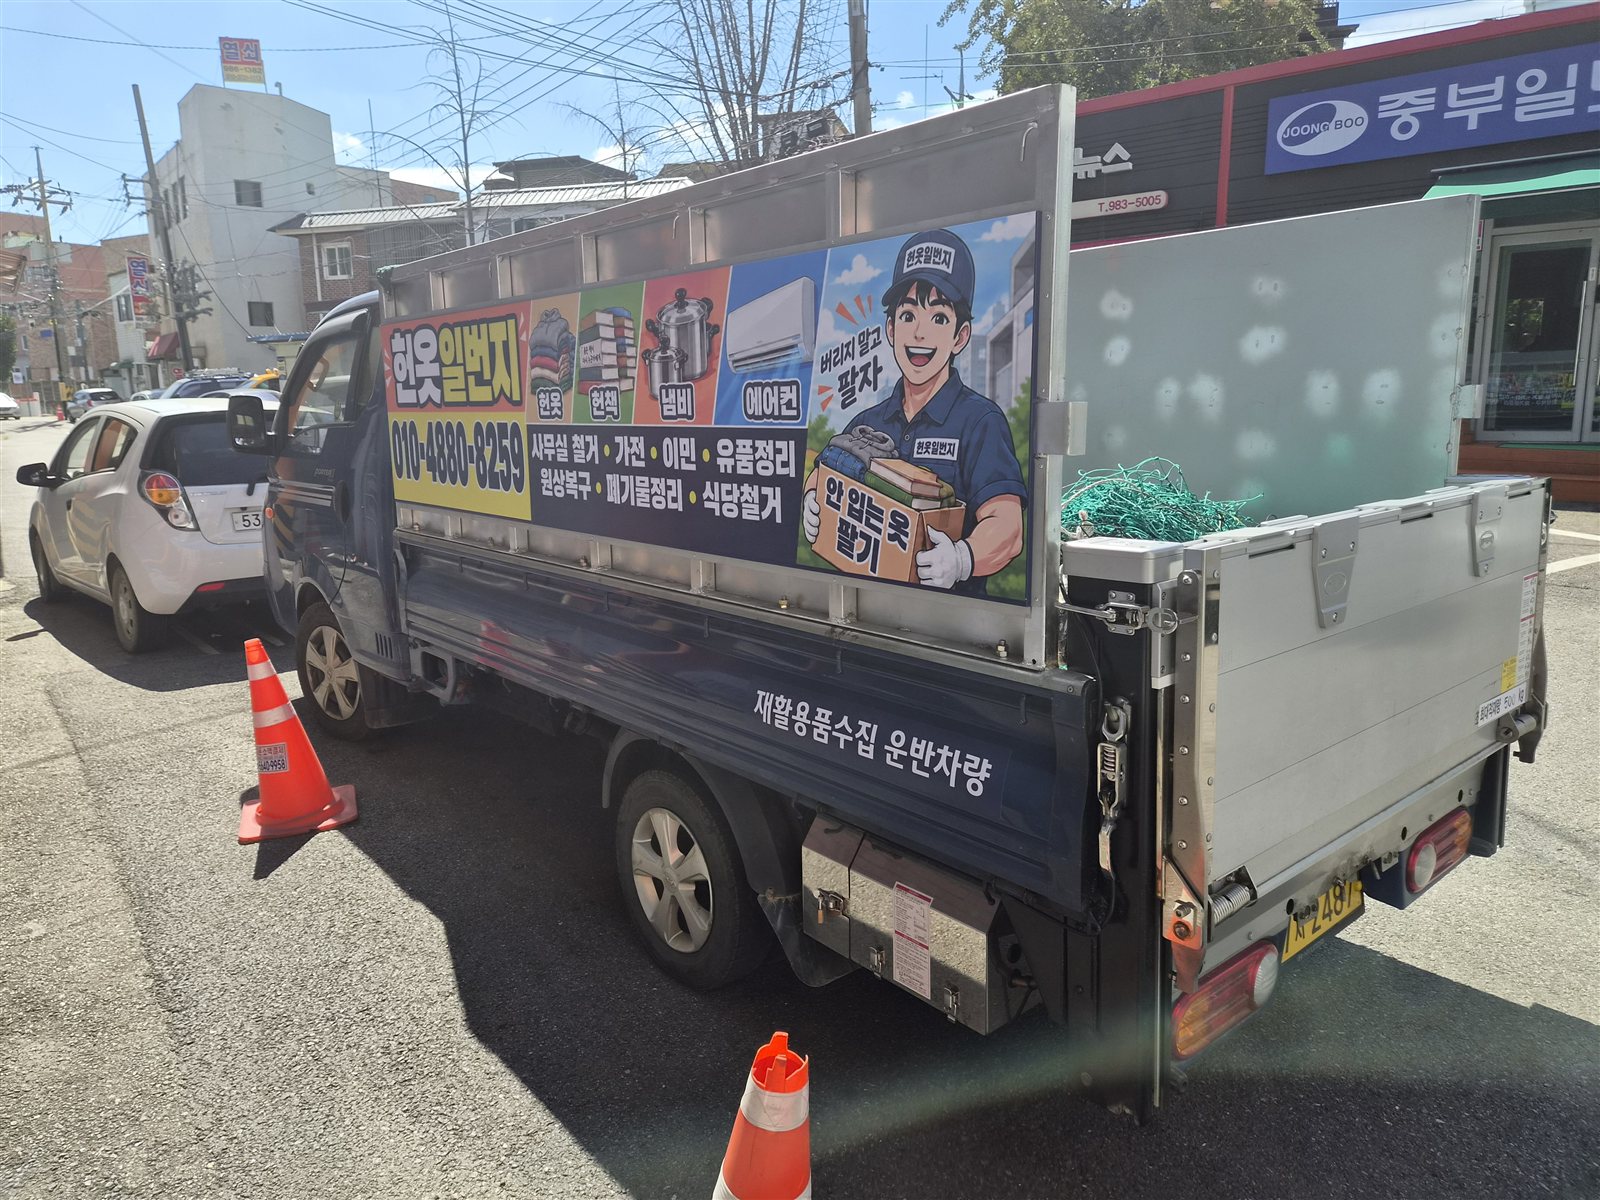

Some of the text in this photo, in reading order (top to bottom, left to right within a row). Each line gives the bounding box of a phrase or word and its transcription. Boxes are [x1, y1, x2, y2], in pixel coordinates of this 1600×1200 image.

[222, 41, 260, 63] 열쇠
[1378, 62, 1600, 141] 중부일
[1282, 115, 1365, 139] JOONG BOO
[1073, 142, 1133, 180] 뉴스
[1098, 194, 1162, 213] T.983-5005
[905, 247, 954, 270] 헌옷일번지
[390, 317, 522, 408] 헌옷일번지
[820, 325, 883, 375] 버리지 말고
[660, 386, 693, 416] 냄비
[744, 383, 799, 418] 에어컨
[837, 355, 884, 411] 팔자
[538, 391, 563, 418] 헌옷
[590, 390, 619, 418] 헌책
[391, 419, 526, 494] 010-4880-8259
[532, 433, 796, 478] 사무실 철거 가전 이민 유품정리
[916, 439, 958, 459] 헌옷일번지
[540, 468, 782, 523] 원상복구 폐기물정리 식당철거
[824, 477, 911, 552] 안 입는 옷
[241, 513, 261, 528] 53
[835, 515, 882, 575] 팔기
[753, 689, 993, 797] 재활용품수집 운반차량
